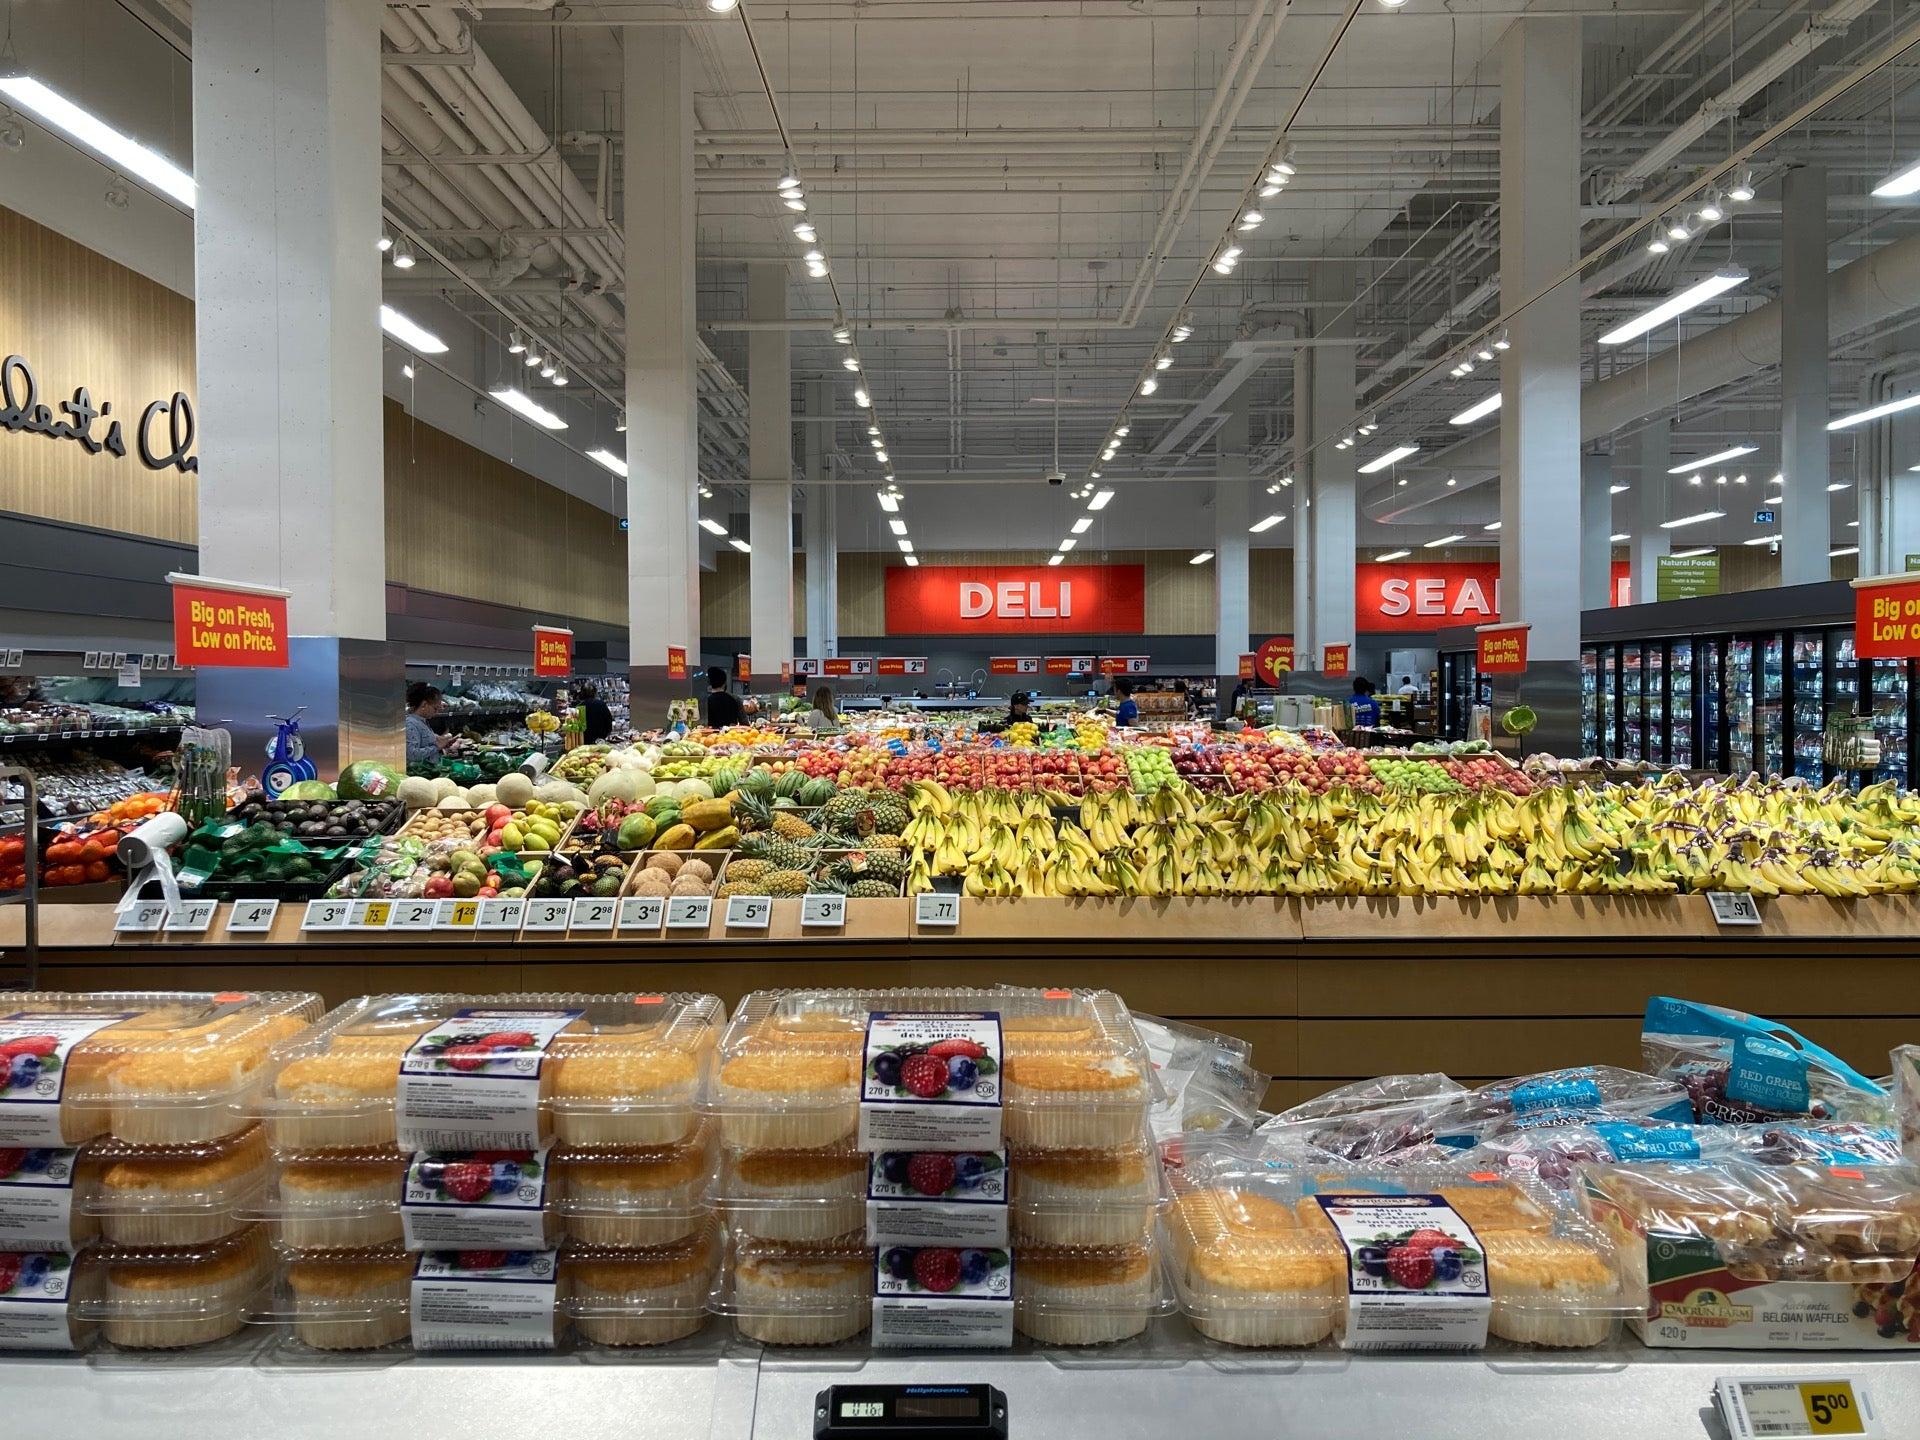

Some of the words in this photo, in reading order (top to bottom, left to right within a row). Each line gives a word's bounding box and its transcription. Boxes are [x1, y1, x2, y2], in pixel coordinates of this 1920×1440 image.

[960, 582, 1071, 618] DELI
[1379, 578, 1500, 616] SEA
[1873, 597, 1900, 621] Big
[191, 601, 215, 627] Big
[218, 607, 235, 625] on
[237, 605, 275, 632] Fresh,
[192, 626, 221, 648] Low
[223, 632, 241, 650] on
[243, 630, 277, 651] Price.
[1873, 622, 1907, 641] Low
[1268, 645, 1295, 653] Always
[1739, 1069, 1764, 1082] RED
[868, 1087, 883, 1095] 270
[885, 1088, 890, 1097] g
[1524, 1096, 1566, 1110] GRAPES
[1704, 1100, 1756, 1124] CRISP
[425, 1191, 431, 1200] g
[875, 1184, 890, 1192] 270
[891, 1185, 896, 1193] g
[881, 1281, 896, 1289] 270
[897, 1282, 902, 1290] g
[1356, 1279, 1371, 1287] 270
[1372, 1280, 1378, 1288] g
[1762, 1311, 1804, 1323] BELGIAN
[1805, 1312, 1850, 1324] WAFFLES
[1660, 1326, 1679, 1339] 420
[1680, 1329, 1687, 1341] g
